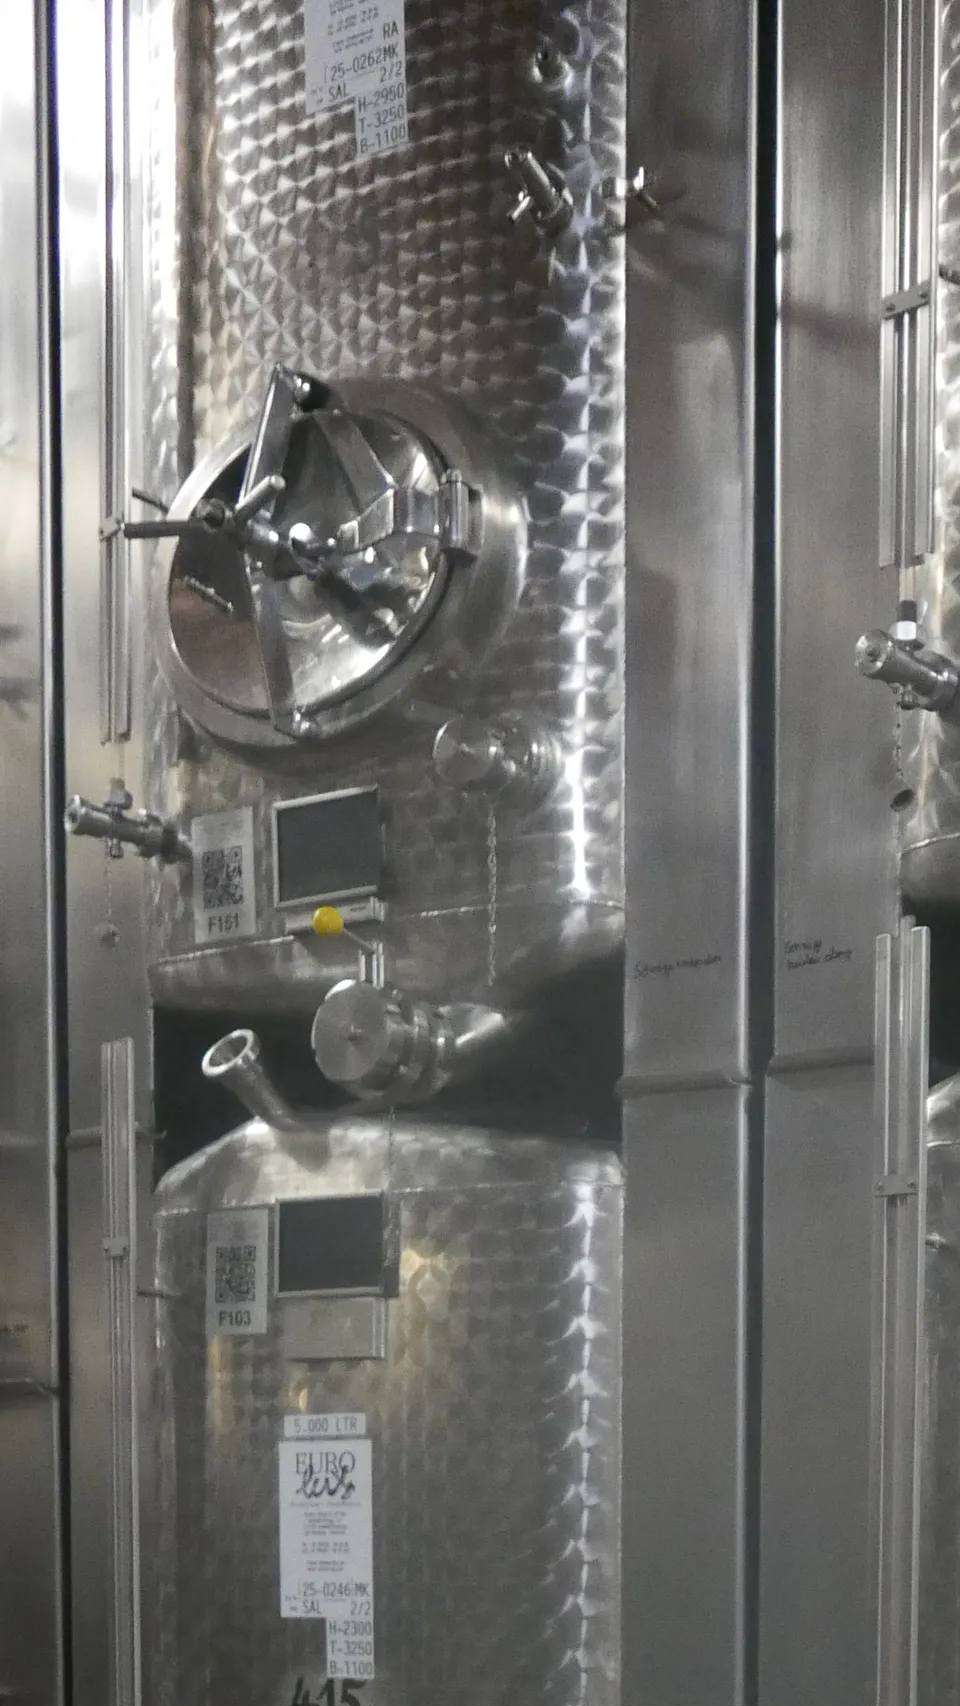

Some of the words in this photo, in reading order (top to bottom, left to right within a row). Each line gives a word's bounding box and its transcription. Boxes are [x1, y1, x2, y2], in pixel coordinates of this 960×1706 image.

[383, 20, 398, 40] RA
[328, 84, 349, 102] SAL
[380, 60, 402, 83] 2/2
[357, 82, 404, 113] H-2950
[359, 104, 404, 133] T-3250
[360, 124, 405, 153] B-1100
[218, 1310, 251, 1327] F103
[294, 1418, 328, 1434] 5.000
[336, 1417, 357, 1432] LTR
[295, 1451, 356, 1475] EURO
[303, 1581, 351, 1598] 25-0246
[354, 1581, 370, 1597] MK
[302, 1600, 322, 1615] SAL
[350, 1600, 372, 1616] 2/2
[328, 1620, 372, 1636] H-2300
[330, 1641, 372, 1656] T-3250
[330, 1660, 373, 1676] B-1100
